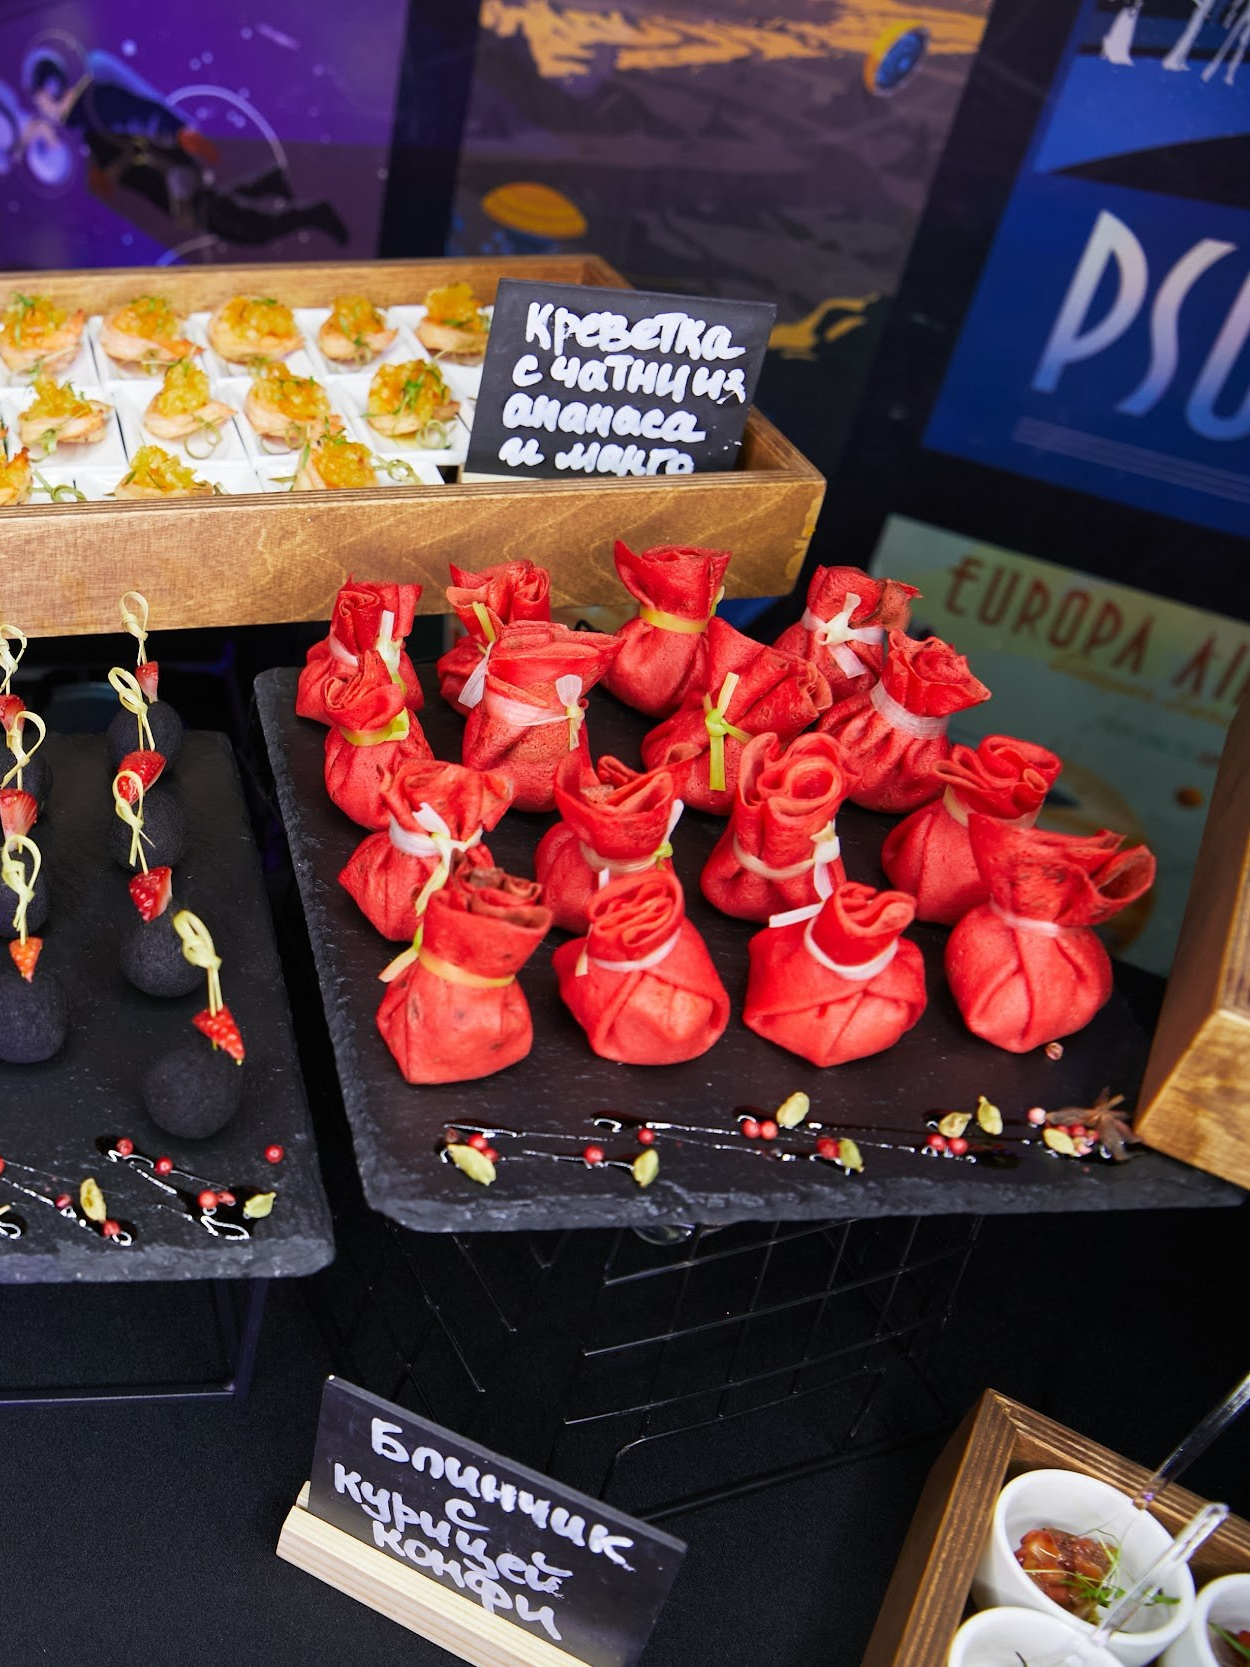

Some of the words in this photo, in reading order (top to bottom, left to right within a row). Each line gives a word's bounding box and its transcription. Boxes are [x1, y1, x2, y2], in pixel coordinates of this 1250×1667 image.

[526, 302, 746, 360] Креветка
[550, 354, 690, 403] чатни
[502, 393, 706, 443] ананаса
[499, 437, 545, 467] и
[554, 442, 695, 476] манго
[944, 556, 1157, 675] EUROPA
[1171, 633, 1250, 706] AI
[370, 1417, 636, 1572] Блинчик
